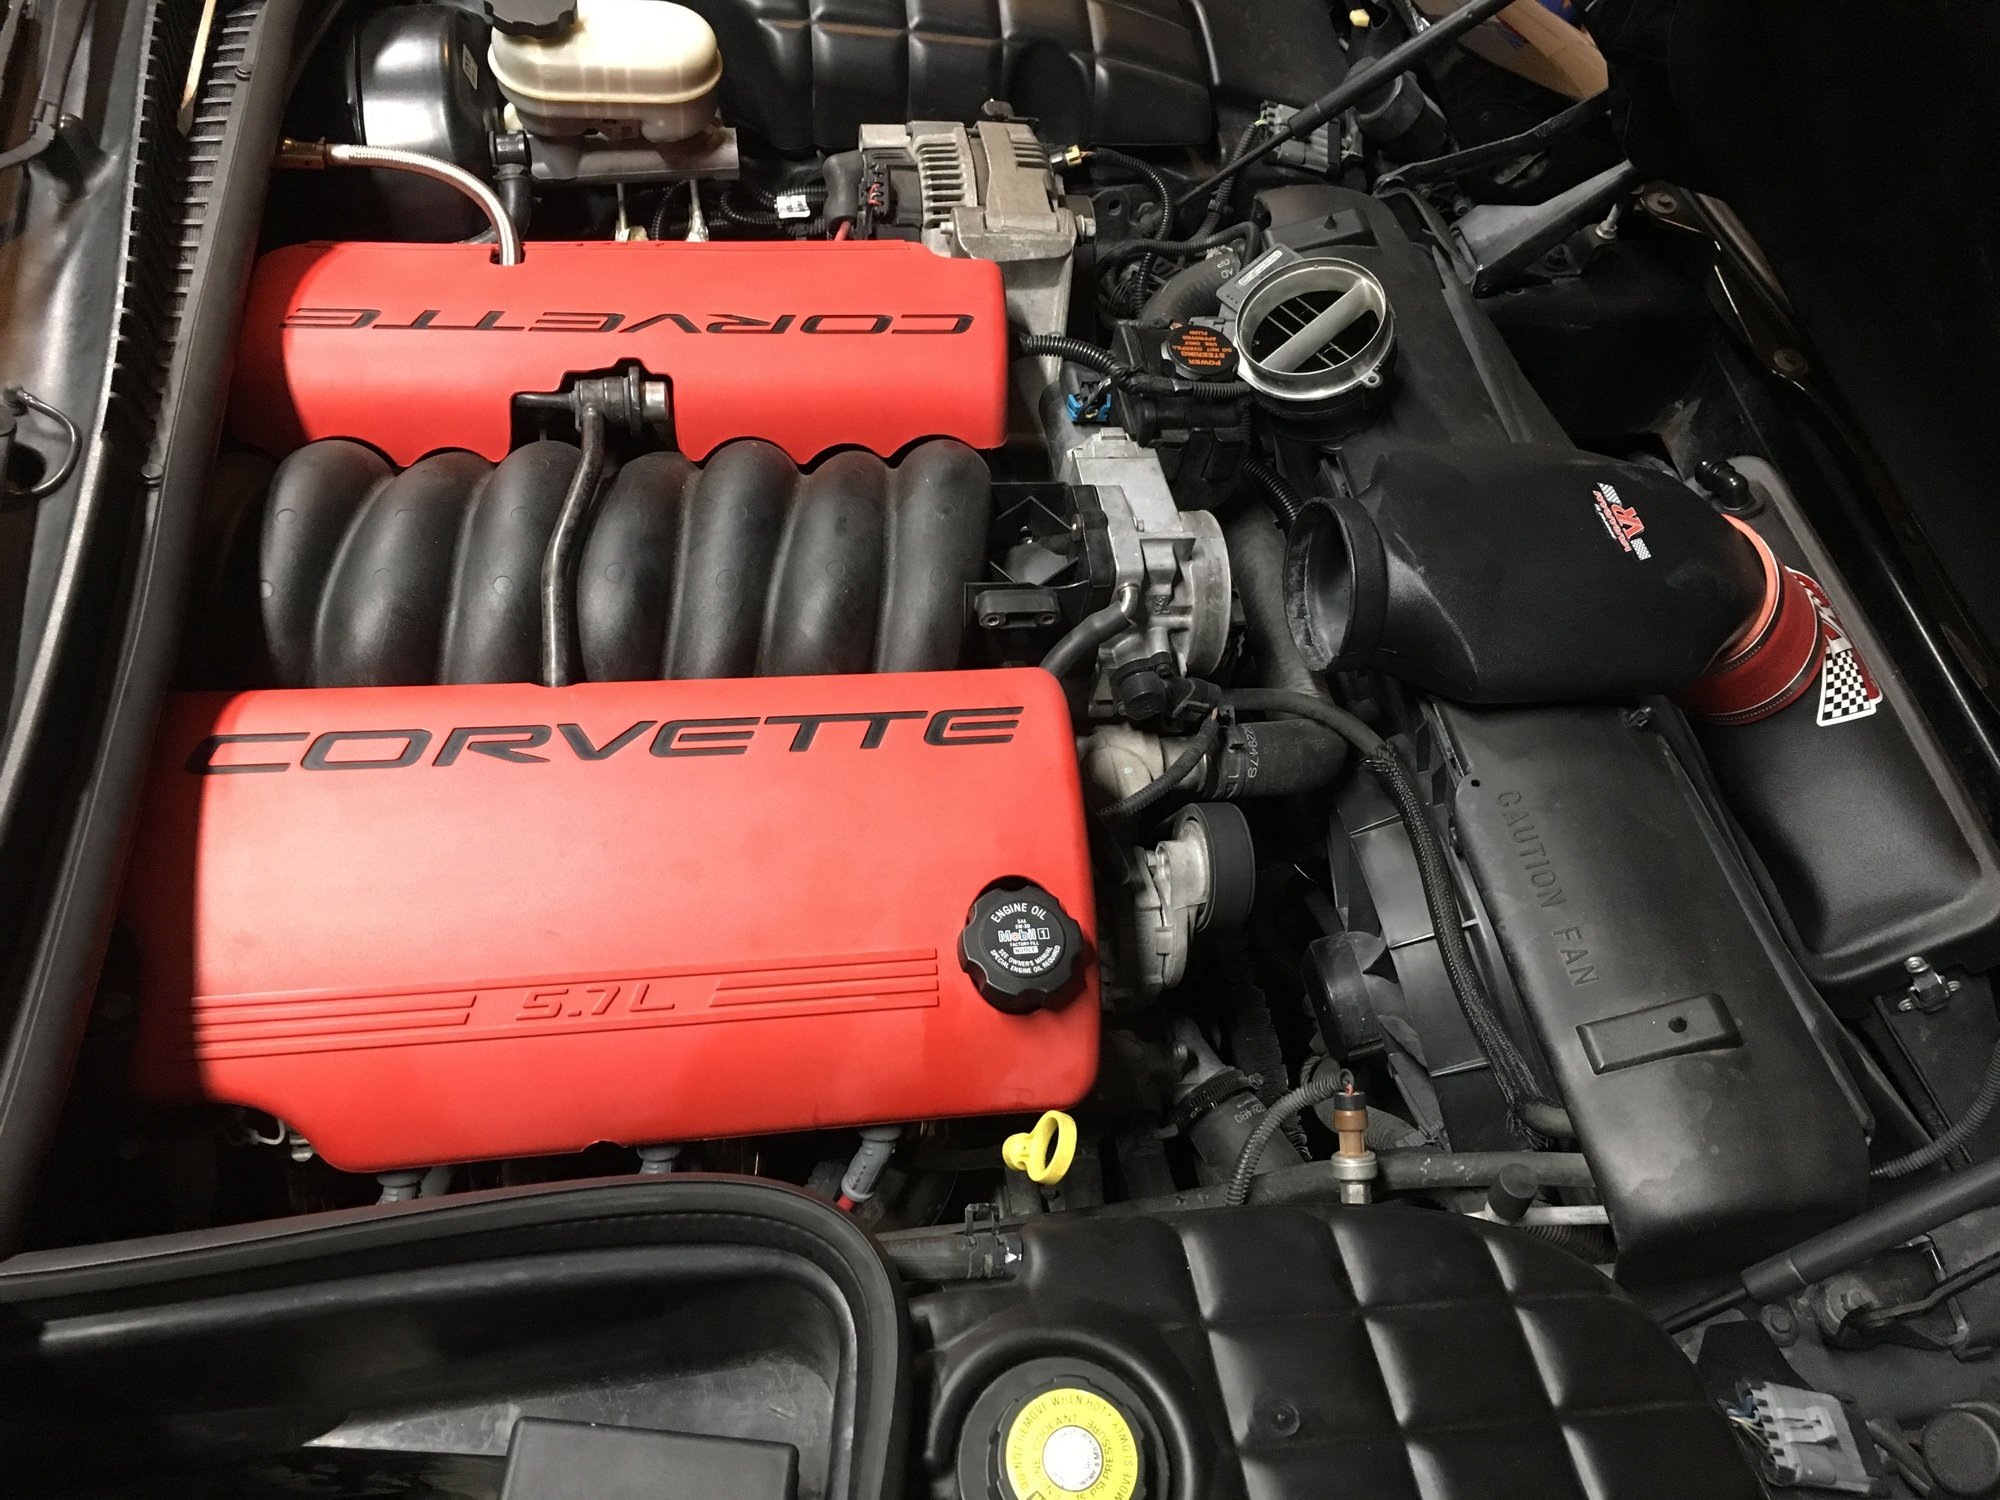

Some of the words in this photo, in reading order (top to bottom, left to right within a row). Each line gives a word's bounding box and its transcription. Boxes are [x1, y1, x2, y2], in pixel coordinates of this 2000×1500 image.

[278, 307, 974, 334] CORVETTE
[184, 706, 1024, 776] CORVETTE
[1497, 791, 1566, 908] CAUTION
[1552, 926, 1600, 986] FAN
[990, 902, 1028, 923] ENGINE
[1031, 906, 1046, 920] OIL
[998, 928, 1037, 942] Mobil
[990, 949, 1009, 968] SPECIAL
[1042, 945, 1060, 968] REQUIRED
[998, 948, 1009, 959] SEE
[1009, 957, 1034, 967] OWNER'S
[1034, 946, 1053, 964] MANUAL
[516, 984, 674, 1020] 5.7L
[1051, 1394, 1082, 1407] WHEN
[1086, 1398, 1107, 1415] HOT
[1016, 1401, 1048, 1442] REMOVE
[1032, 1414, 1078, 1452] COOLANT
[1085, 1418, 1114, 1480] PRESSURE
[1112, 1420, 1134, 1466] SLOWLY
[1012, 1446, 1023, 1470] NOT
[1017, 1472, 1029, 1490] DO
[1089, 1480, 1107, 1498] PSI
